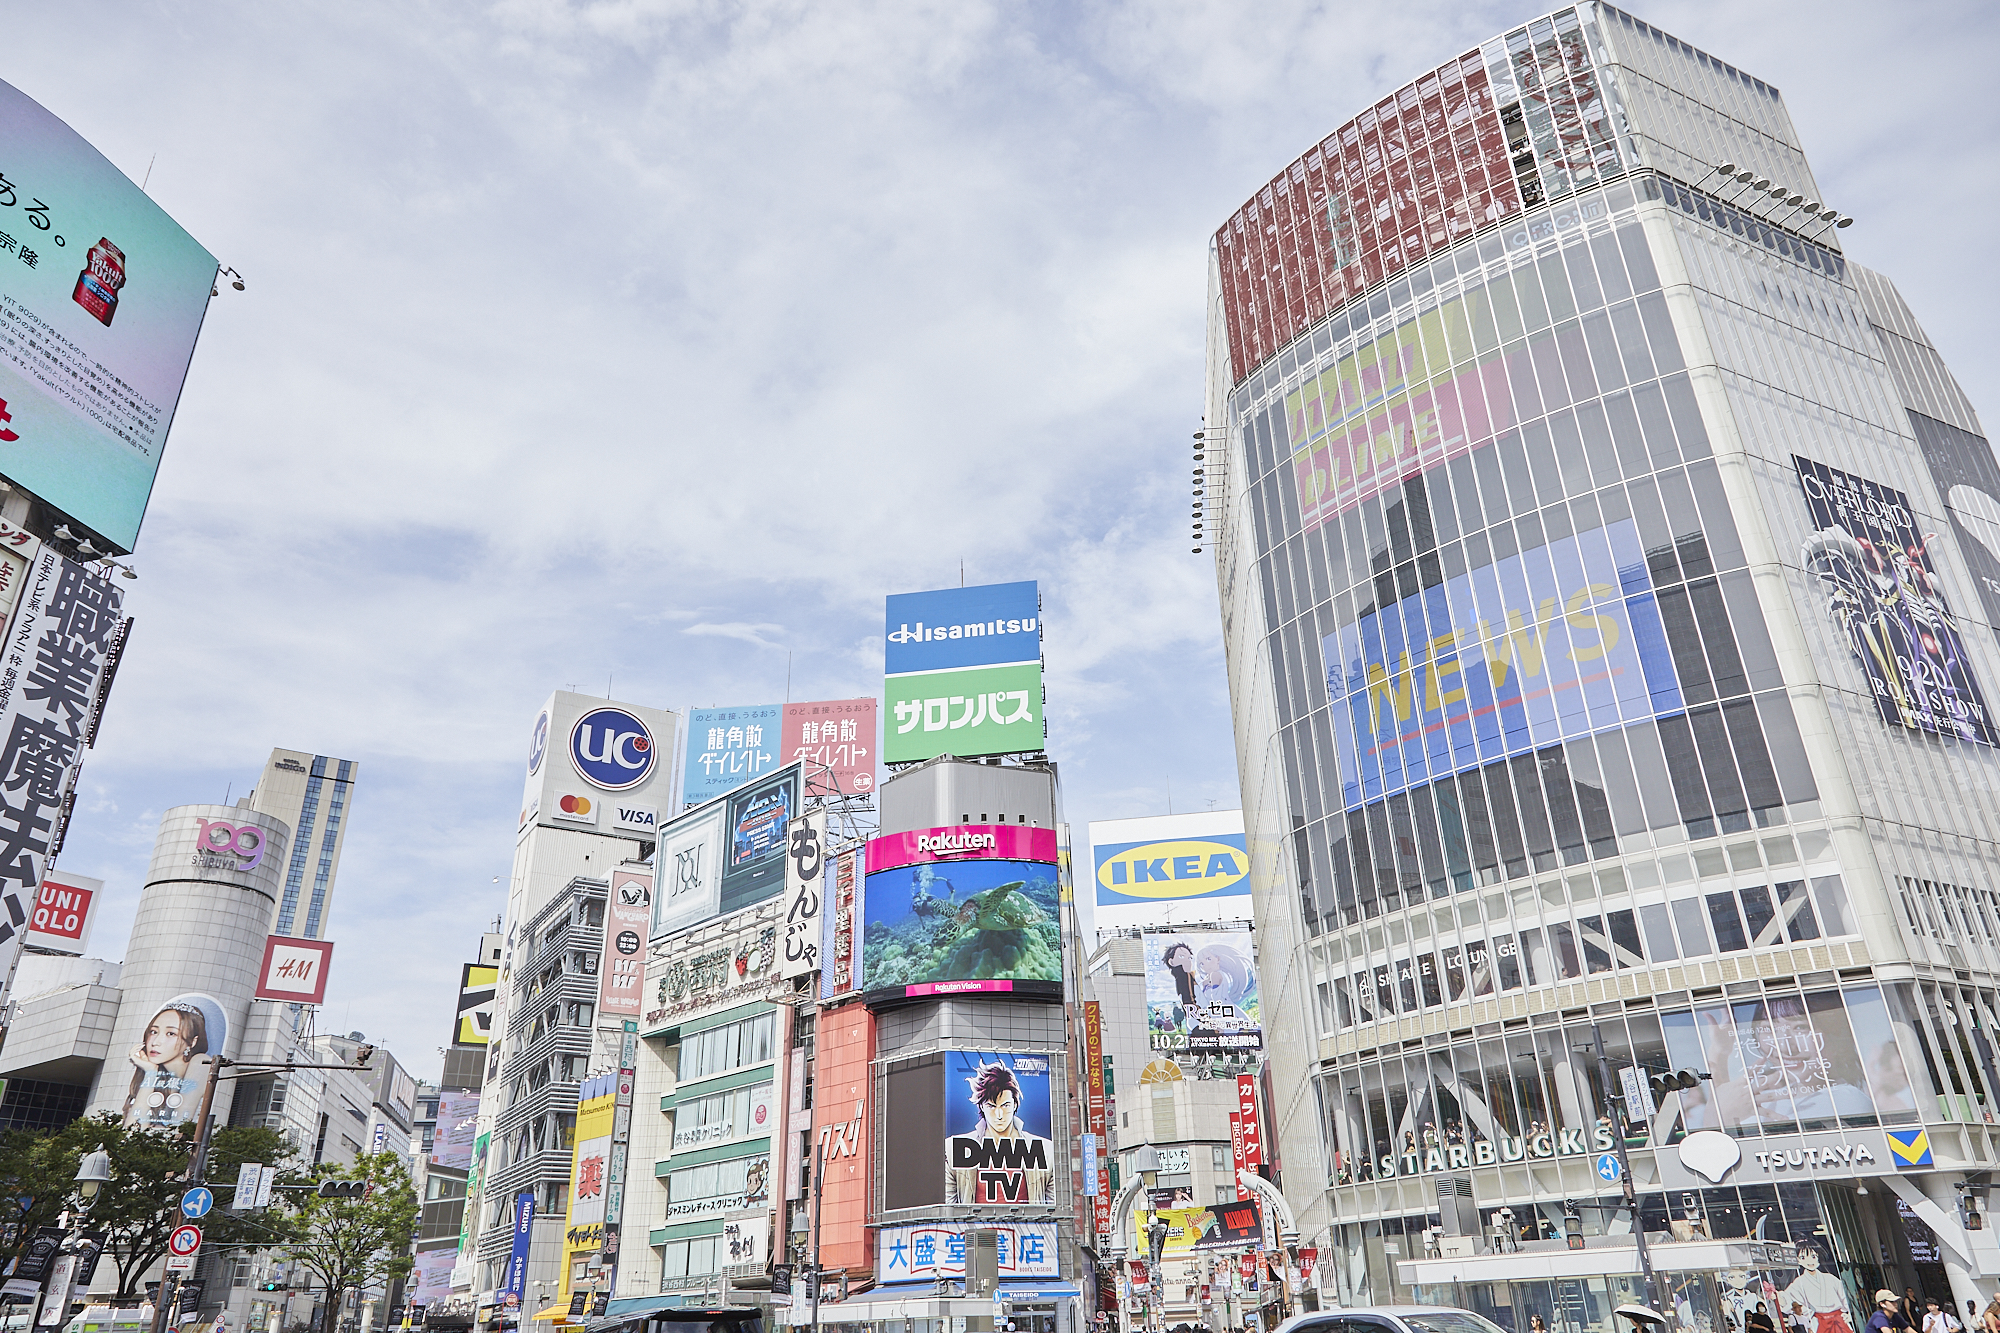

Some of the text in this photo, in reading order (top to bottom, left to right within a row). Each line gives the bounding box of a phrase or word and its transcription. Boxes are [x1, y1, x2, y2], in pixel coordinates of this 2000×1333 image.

[1512, 201, 1603, 247] QFRONT
[90, 259, 120, 290] 1000
[91, 250, 123, 282] Yakult
[0, 305, 158, 425] (眠りの深さ、すっきりとした目覚め)を高める機能があり
[1803, 473, 1913, 528] OVERLORD
[888, 618, 1037, 644] Hisamitsu
[1368, 582, 1620, 735] NEWS
[789, 704, 872, 716] のど、直接、うるおう
[894, 690, 1033, 734] サロンパス
[1872, 676, 1984, 722] ROADSHOW
[695, 710, 777, 722] のど、直接、うるおう
[707, 724, 763, 750] 龍角散
[802, 718, 858, 745] 龍角散
[580, 723, 648, 770] UC
[793, 744, 868, 768] ダイレクト
[274, 761, 306, 773] INDIGO
[697, 749, 772, 776] ダイレクト
[705, 776, 735, 785] スティック
[855, 777, 872, 787] 生薬
[559, 813, 590, 822] mastercard
[616, 807, 655, 826] VISA
[196, 817, 268, 871] 109
[918, 831, 996, 853] Rakuten
[191, 855, 236, 871] SHIBUYA
[1111, 852, 1242, 886] IKEA
[40, 887, 82, 912] UNI
[785, 817, 821, 968] もんじゃ
[34, 908, 79, 932] QLO
[832, 854, 852, 987] 三千里薬品
[277, 957, 314, 982] H&M
[614, 959, 638, 973] B1F
[934, 982, 982, 993] Rakuten Vision
[1218, 1034, 1260, 1047] 放送開始
[1734, 1030, 1825, 1059] 絶対的
[1756, 1026, 1771, 1034] 12th
[1087, 1004, 1101, 1088] クスリのことなら
[1739, 1057, 1836, 1089] 第六感
[1775, 1087, 1797, 1097] NOW
[1799, 1085, 1815, 1094] ON
[133, 1109, 190, 1118] HARNE
[1090, 1095, 1105, 1149] 三千里
[1239, 1083, 1260, 1155] カラオケ
[951, 1137, 1049, 1170] DMM
[1231, 1121, 1243, 1161] BIG ECHO
[1380, 1125, 1616, 1179] STARBUCKS
[1755, 1142, 1874, 1169] TSUTAYA
[577, 1156, 604, 1200] 薬
[1084, 1136, 1095, 1193] 大盛堂商事ビル
[980, 1172, 1022, 1201] TV
[520, 1201, 532, 1234] MIZUHO
[667, 1201, 716, 1217] ジャスミンレディース
[716, 1196, 743, 1209] クリニック
[1096, 1182, 1110, 1233] 七輪焼肉
[1100, 1233, 1111, 1259] 牛繁
[512, 1255, 523, 1292] みずほ銀行
